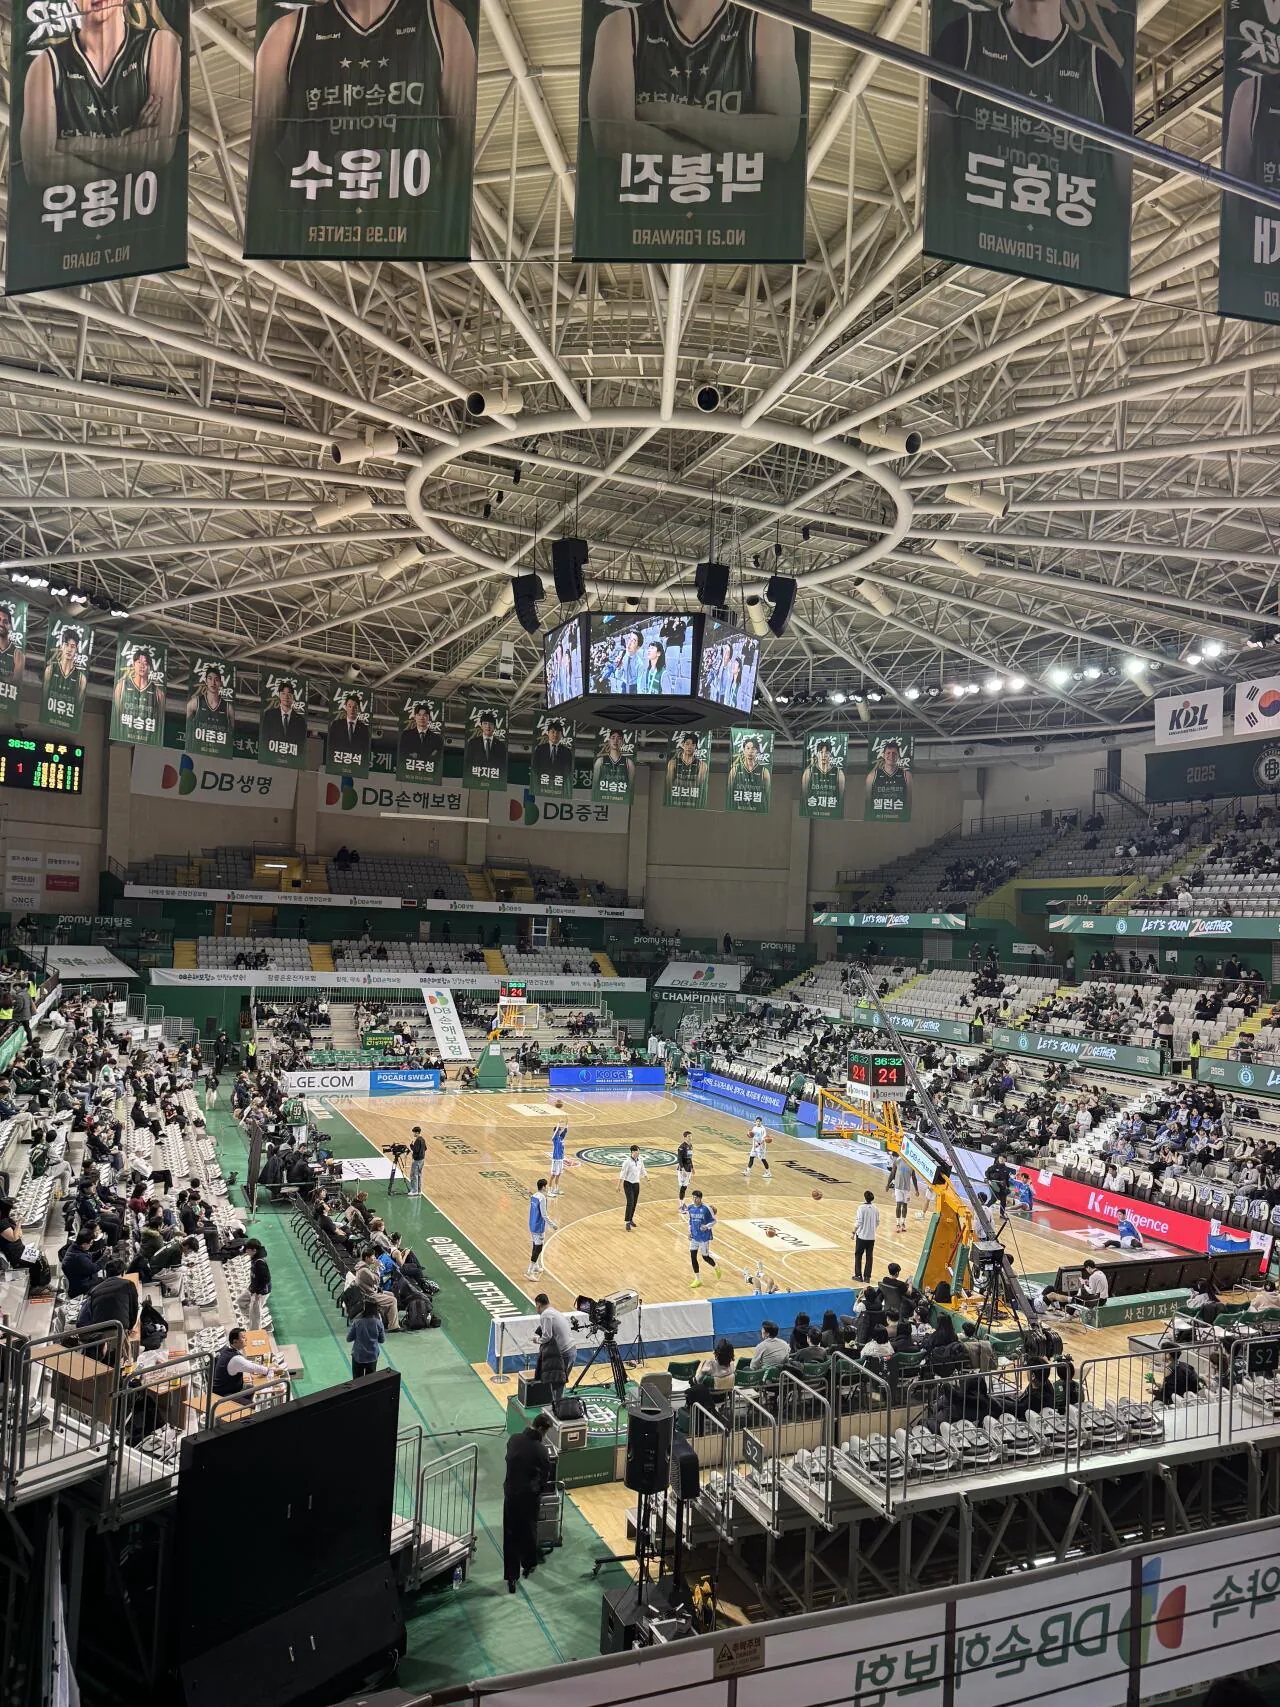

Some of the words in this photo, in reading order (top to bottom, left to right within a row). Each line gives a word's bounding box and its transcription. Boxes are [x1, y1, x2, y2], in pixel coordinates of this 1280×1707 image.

[47, 697, 75, 718] 이유진
[121, 713, 156, 733] 백승엽
[1169, 702, 1209, 731] KBL
[195, 727, 227, 745] 이준희
[8, 738, 36, 750] 36:32
[268, 739, 298, 757] 이광재
[333, 750, 362, 766] 진경석
[405, 758, 435, 773] 김주성
[17, 763, 23, 773] 1
[471, 765, 500, 779] 박지현
[1187, 765, 1216, 783] 2025
[201, 770, 272, 795] DB생명
[554, 774, 563, 786] 준
[599, 780, 628, 793] 인승찬
[361, 786, 462, 811] DB손해보험
[671, 786, 699, 798] 김보배
[543, 801, 609, 822] DB증권
[58, 915, 92, 926] promy
[94, 916, 132, 928] 디지털존
[1141, 918, 1166, 932] LET'S
[1167, 920, 1190, 931] RUN
[633, 936, 660, 946] promy
[671, 979, 728, 988] DB손해보험
[511, 989, 523, 997] 24
[662, 991, 726, 1004] CHAMPIONS
[1037, 1037, 1058, 1050] LET'S
[1060, 1042, 1079, 1054] RUN
[850, 1053, 869, 1065] 36:32
[874, 1057, 903, 1066] 36:32
[852, 1065, 866, 1082] 24
[878, 1068, 898, 1083] 24
[1087, 1191, 1104, 1211] K
[1124, 1301, 1178, 1321] 사진기자석
[1255, 1348, 1273, 1365] S2
[745, 1438, 759, 1464] S2
